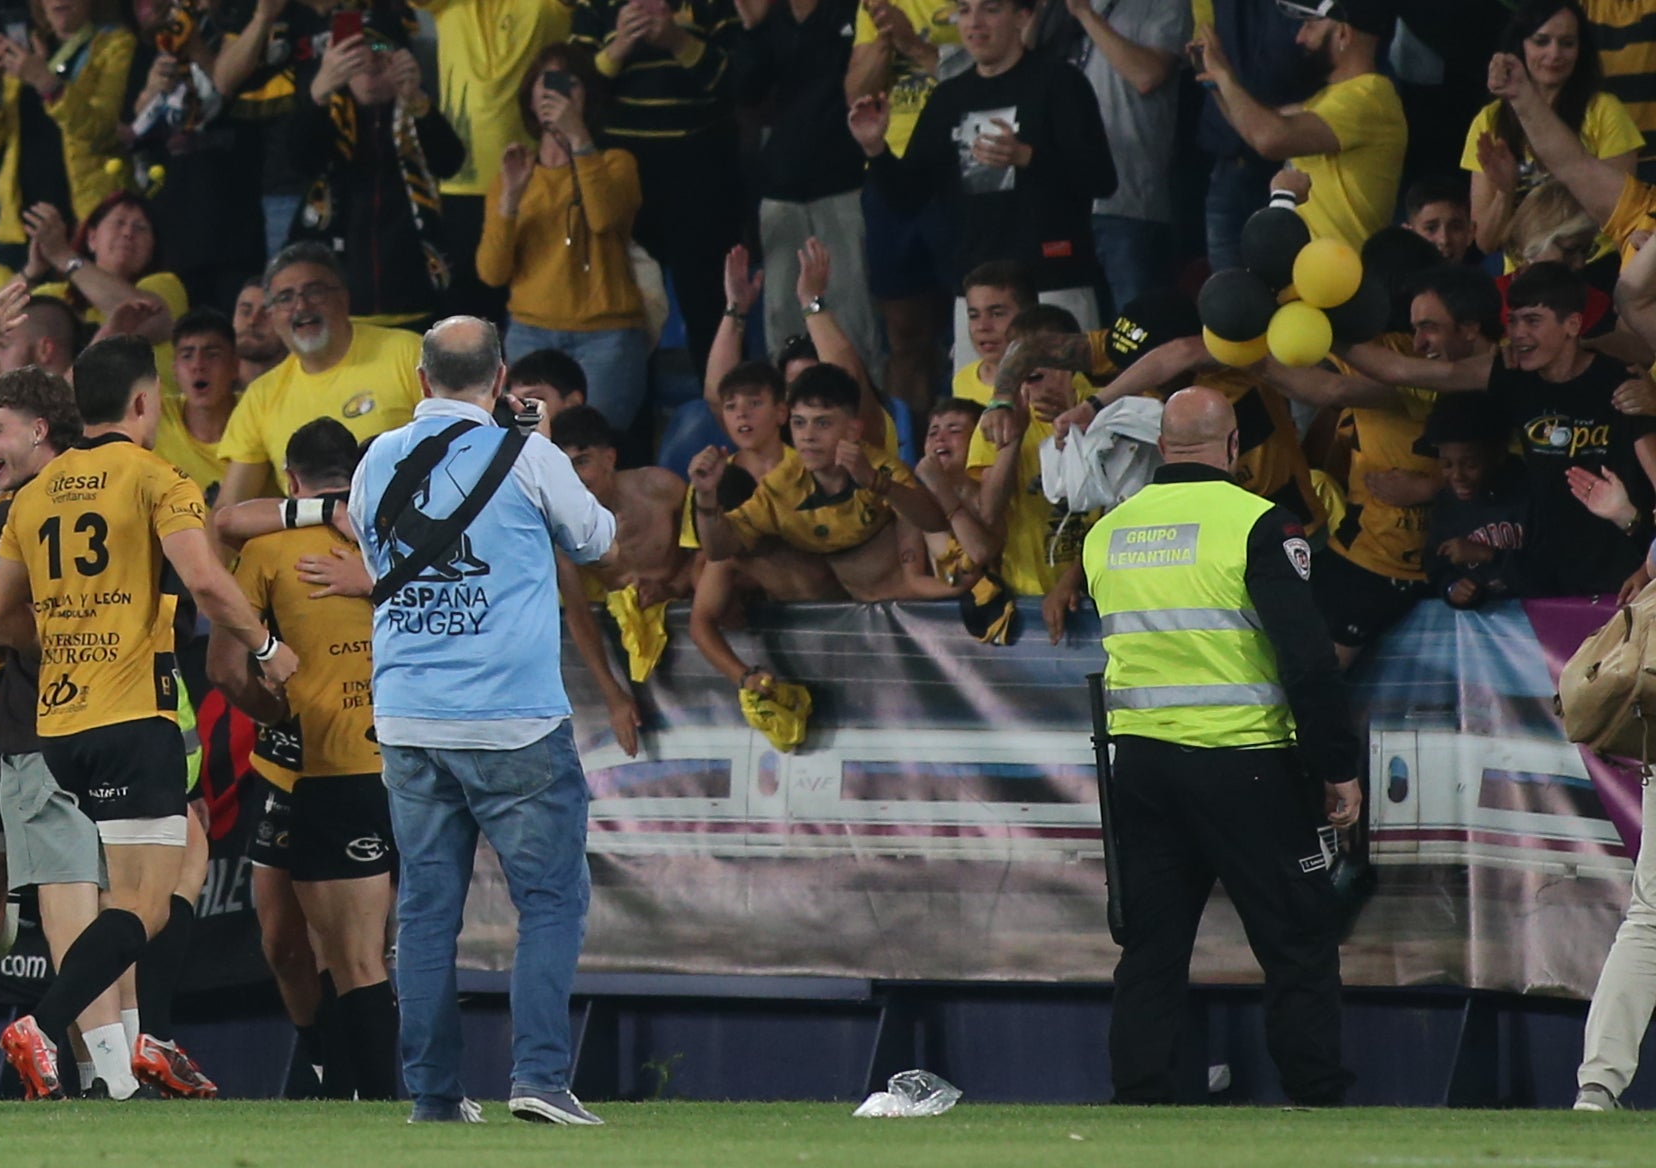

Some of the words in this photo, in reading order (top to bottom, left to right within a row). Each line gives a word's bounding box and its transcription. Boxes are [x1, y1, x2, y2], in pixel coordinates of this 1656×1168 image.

[38, 512, 110, 580] 13
[1125, 527, 1177, 545] GRUPO
[1109, 547, 1192, 567] LEVANTINA
[80, 593, 89, 608] Y
[94, 588, 132, 605] LEÓN
[389, 583, 490, 609] ESPAÑA
[388, 609, 489, 636] RUGBY
